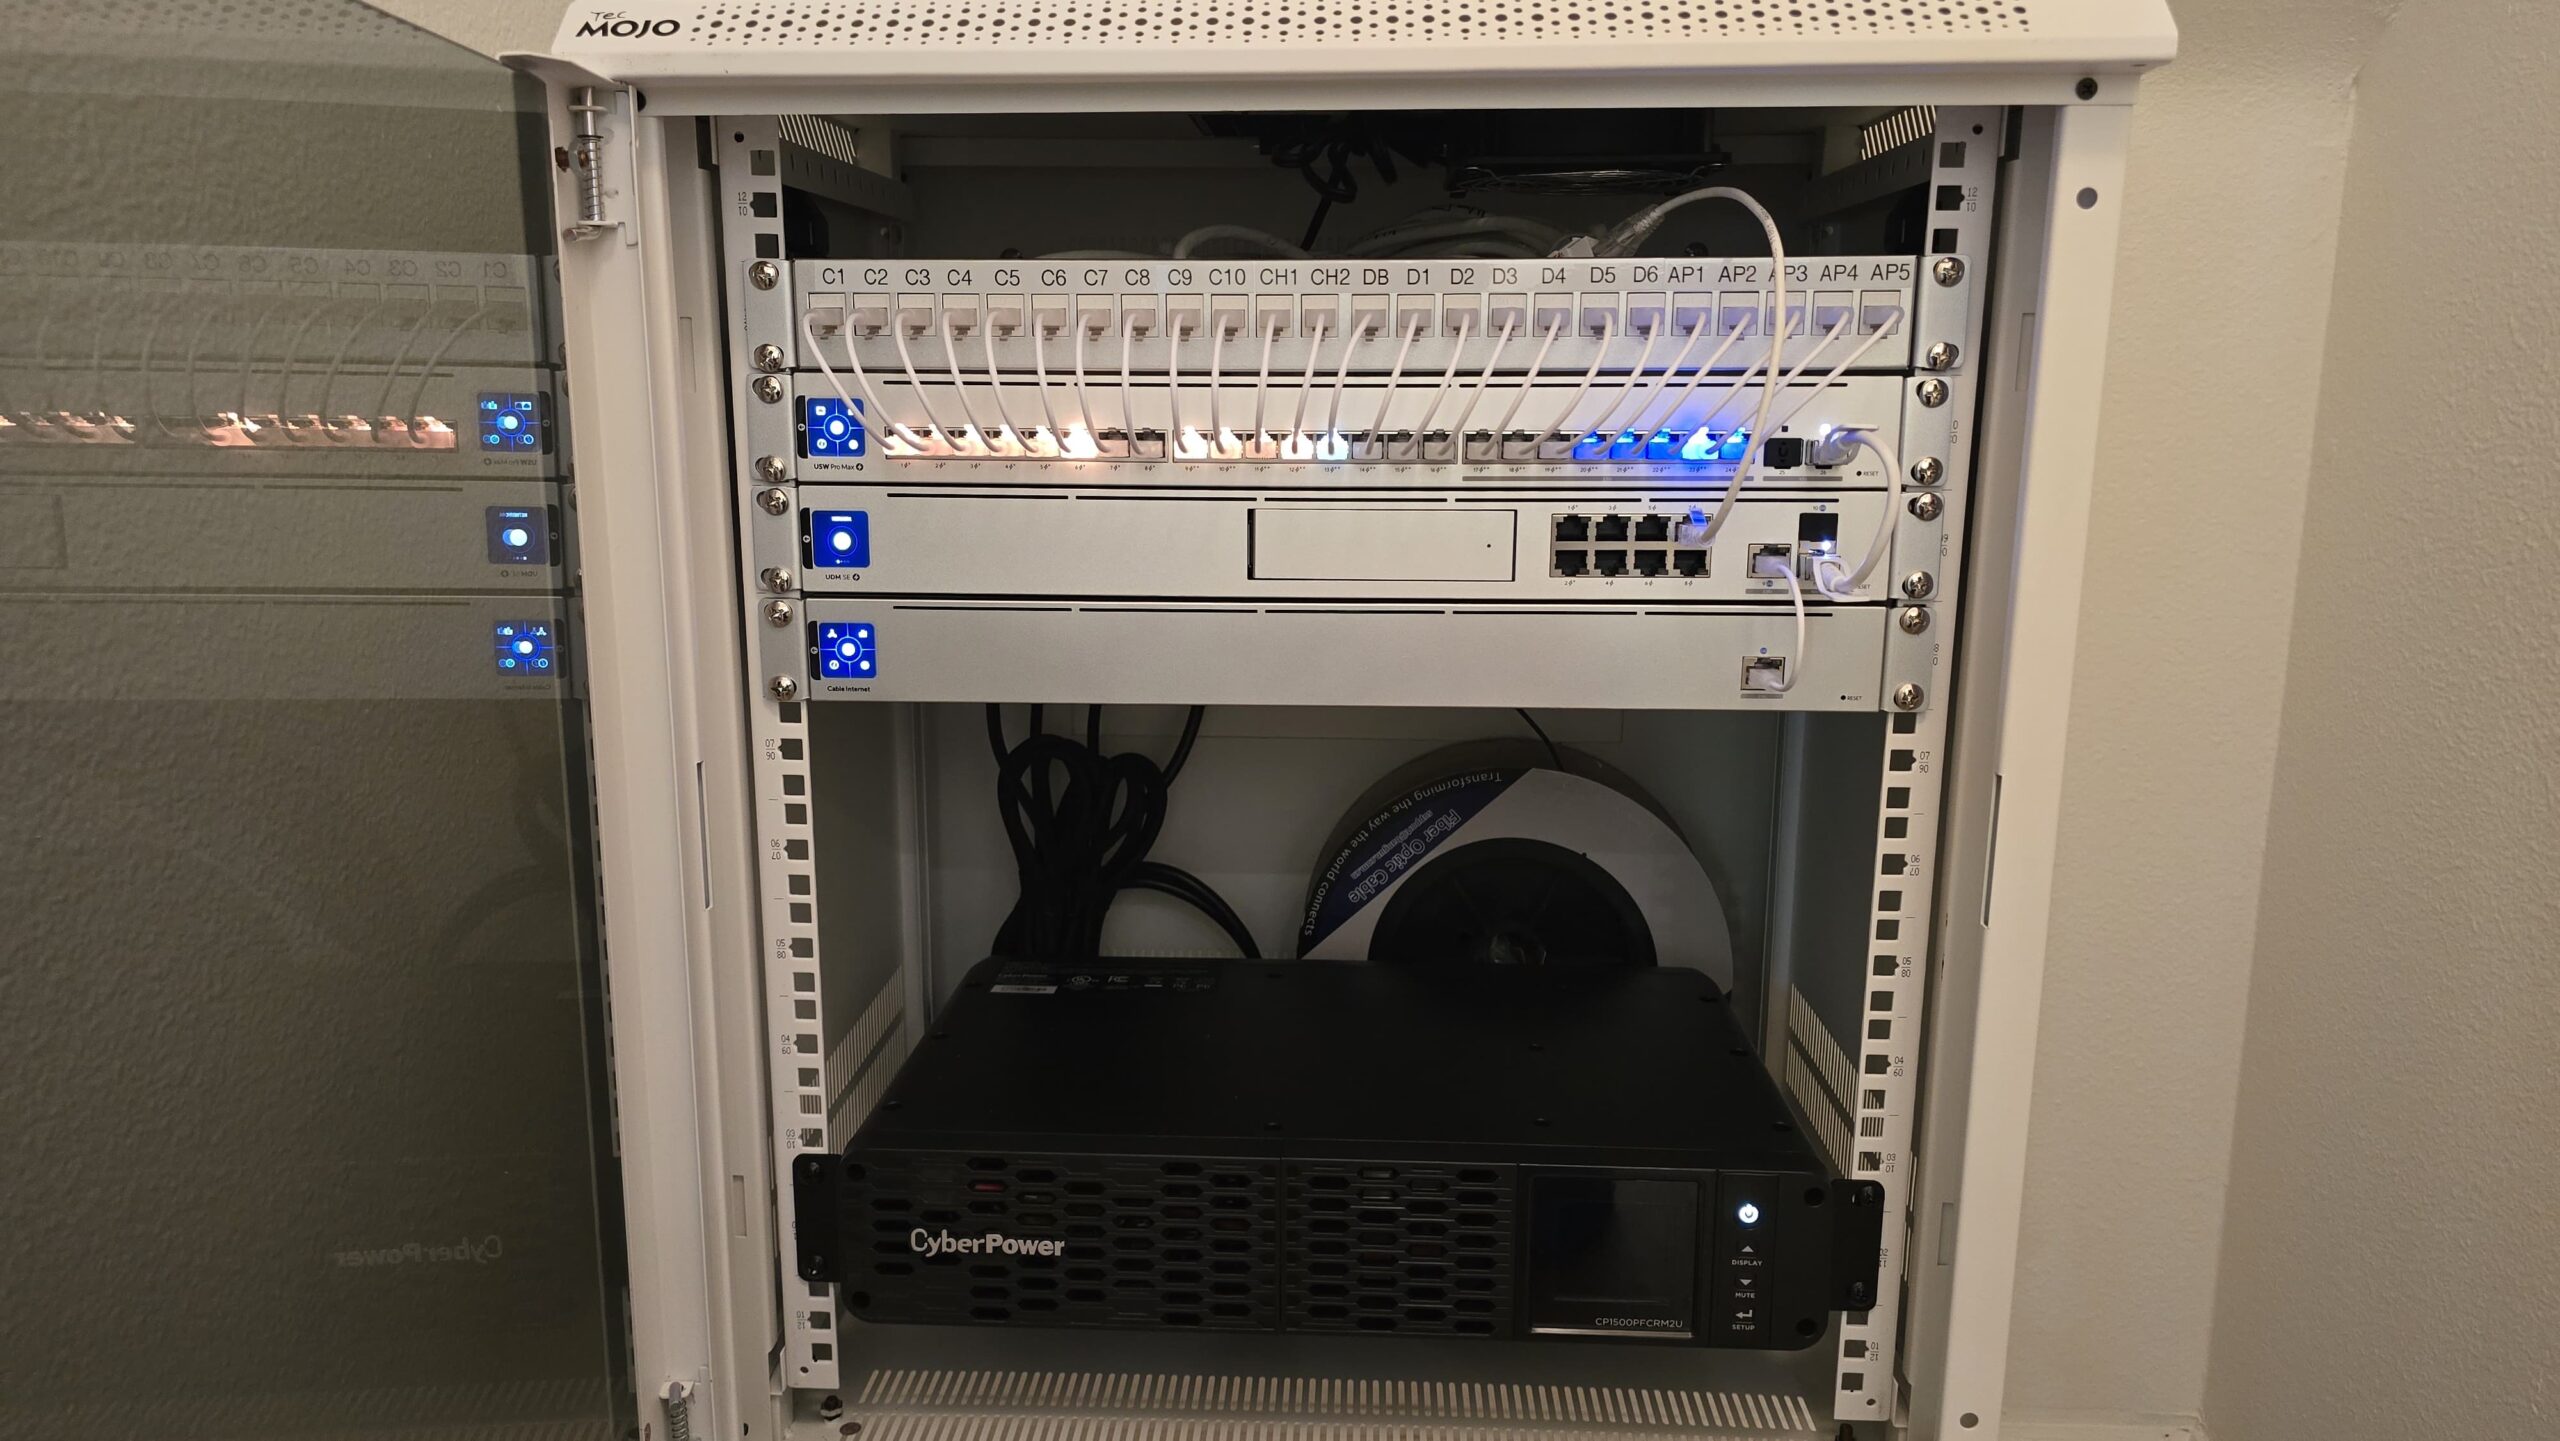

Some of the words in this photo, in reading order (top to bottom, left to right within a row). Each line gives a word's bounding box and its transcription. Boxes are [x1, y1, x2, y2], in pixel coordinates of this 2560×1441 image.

[575, 19, 680, 38] MOJO
[737, 192, 747, 201] 12
[1967, 187, 1978, 197] 12
[823, 268, 845, 285] C1
[864, 269, 888, 286] C2
[905, 269, 931, 286] C3
[948, 269, 973, 286] C4
[995, 269, 1021, 287] C5
[1041, 269, 1067, 287] C6
[1084, 269, 1108, 287] C7
[1125, 269, 1150, 287] C8
[1168, 269, 1192, 286] C9
[1209, 269, 1246, 286] C10
[1260, 269, 1297, 286] CH1
[1311, 269, 1350, 286] CH2
[1364, 269, 1389, 286] DB
[1407, 269, 1430, 286] D1
[1451, 268, 1474, 286] D2
[1493, 268, 1518, 285] D3
[1542, 267, 1566, 284] D4
[1590, 267, 1616, 283] D5
[1634, 266, 1659, 283] D6
[1668, 266, 1704, 283] AP1
[1718, 265, 1757, 283] AP2
[1820, 265, 1858, 282] AP4
[1871, 263, 1910, 281] AP5
[841, 463, 855, 471] Max
[1413, 771, 1503, 801] Transforming
[1391, 798, 1413, 813] the
[1368, 811, 1391, 831] way
[1423, 808, 1462, 843] Fiber
[1350, 830, 1369, 849] the
[1384, 838, 1426, 873] Optic
[1326, 848, 1352, 881] world
[1347, 868, 1389, 903] Cable
[1304, 882, 1329, 936] connects
[911, 1228, 1065, 1257] CyberPower
[1731, 1259, 1763, 1267] DISPLAY
[1595, 1317, 1683, 1328] CP1500PFCRM2U
[1731, 1323, 1756, 1331] SETUP
